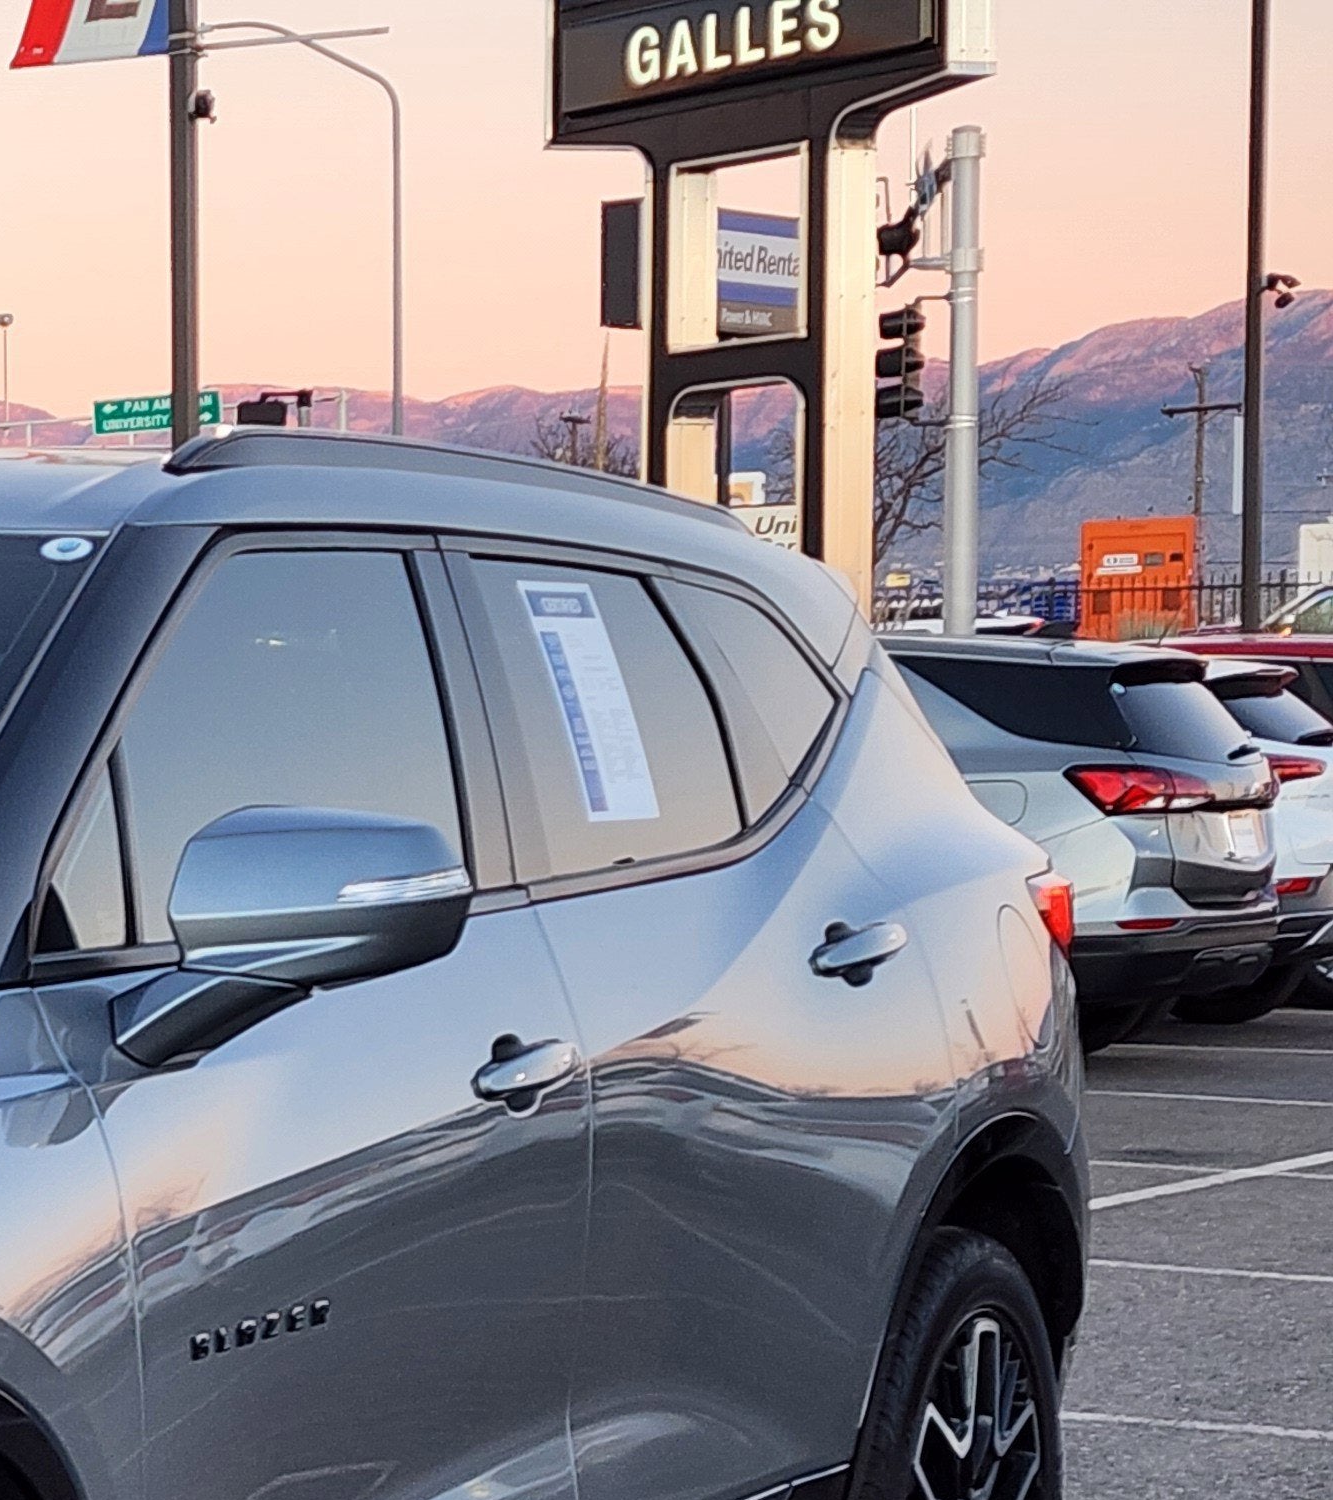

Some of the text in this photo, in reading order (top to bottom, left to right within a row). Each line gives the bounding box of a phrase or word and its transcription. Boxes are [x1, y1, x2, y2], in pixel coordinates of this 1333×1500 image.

[626, 0, 840, 86] GALLES
[717, 241, 799, 277] nited Renta
[123, 400, 149, 413] PAN
[102, 414, 170, 431] UNIVERSITY
[755, 514, 798, 535] Uni
[190, 1298, 330, 1361] BLAZER
